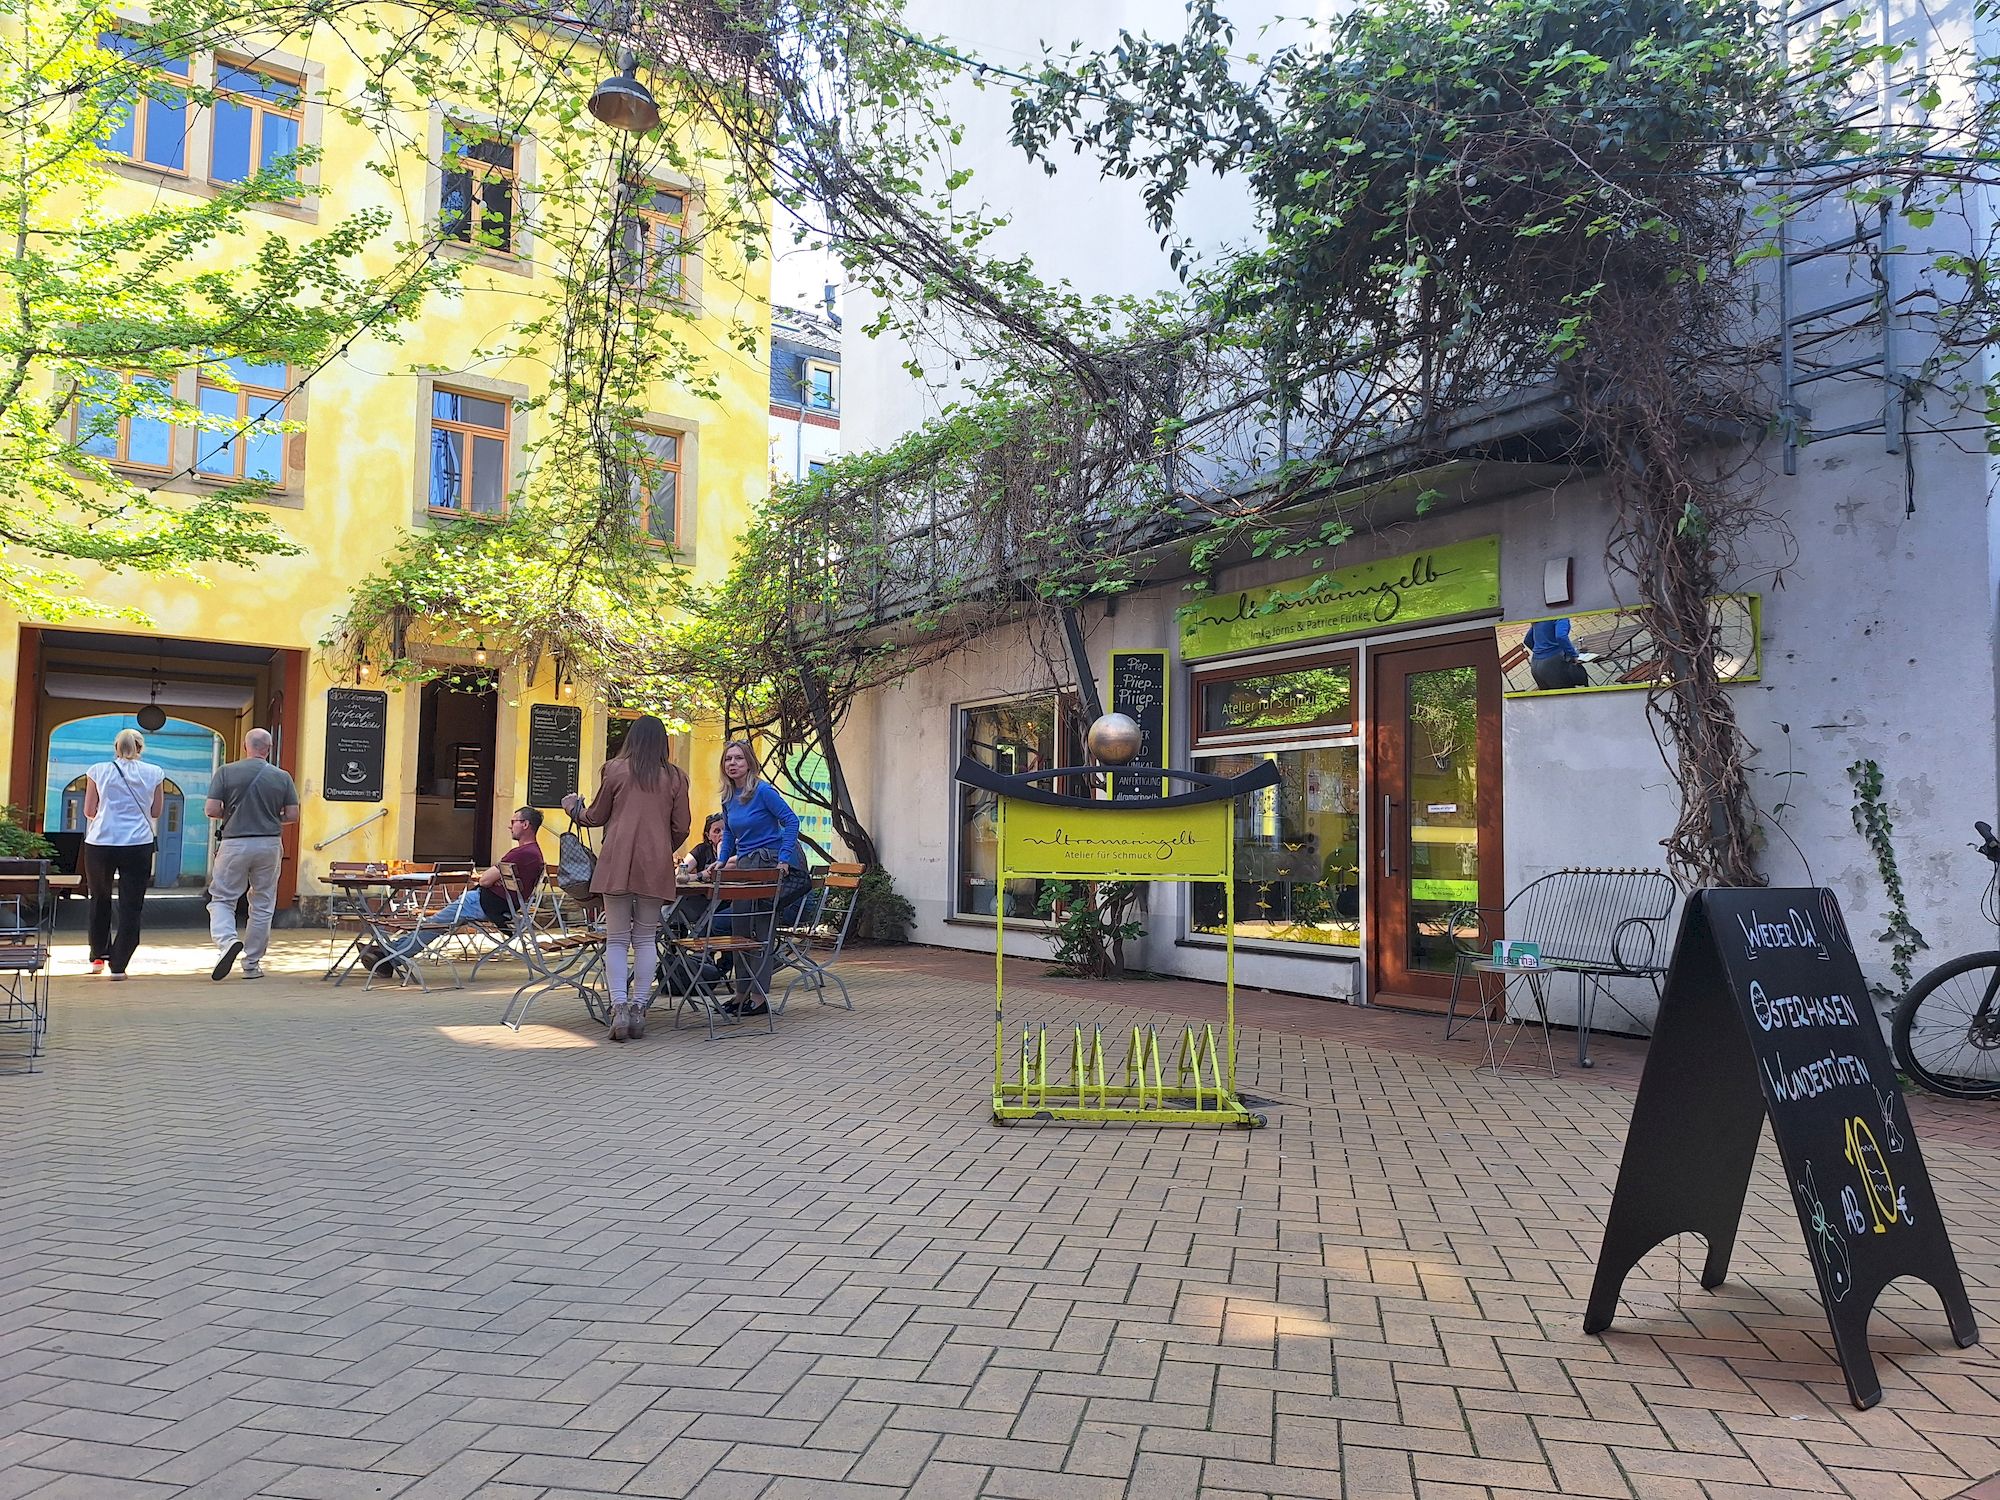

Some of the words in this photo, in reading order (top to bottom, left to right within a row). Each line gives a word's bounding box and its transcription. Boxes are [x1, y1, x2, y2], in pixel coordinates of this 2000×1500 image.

[1199, 554, 1463, 623] ultamaringelb
[1296, 621, 1305, 632] &
[1307, 617, 1338, 630] Patrice
[1340, 610, 1369, 625] Funke
[1221, 700, 1255, 715] Atelier
[1277, 693, 1316, 709] Schmu
[1023, 828, 1210, 861] ultramaringelb
[1065, 850, 1094, 860] Atelier
[1096, 850, 1110, 860] für
[1112, 850, 1152, 860] Schmuck
[1736, 909, 1796, 949] WIEDER
[1750, 980, 1860, 1032] OSTERHASEN
[1840, 1185, 1866, 1235] AB
